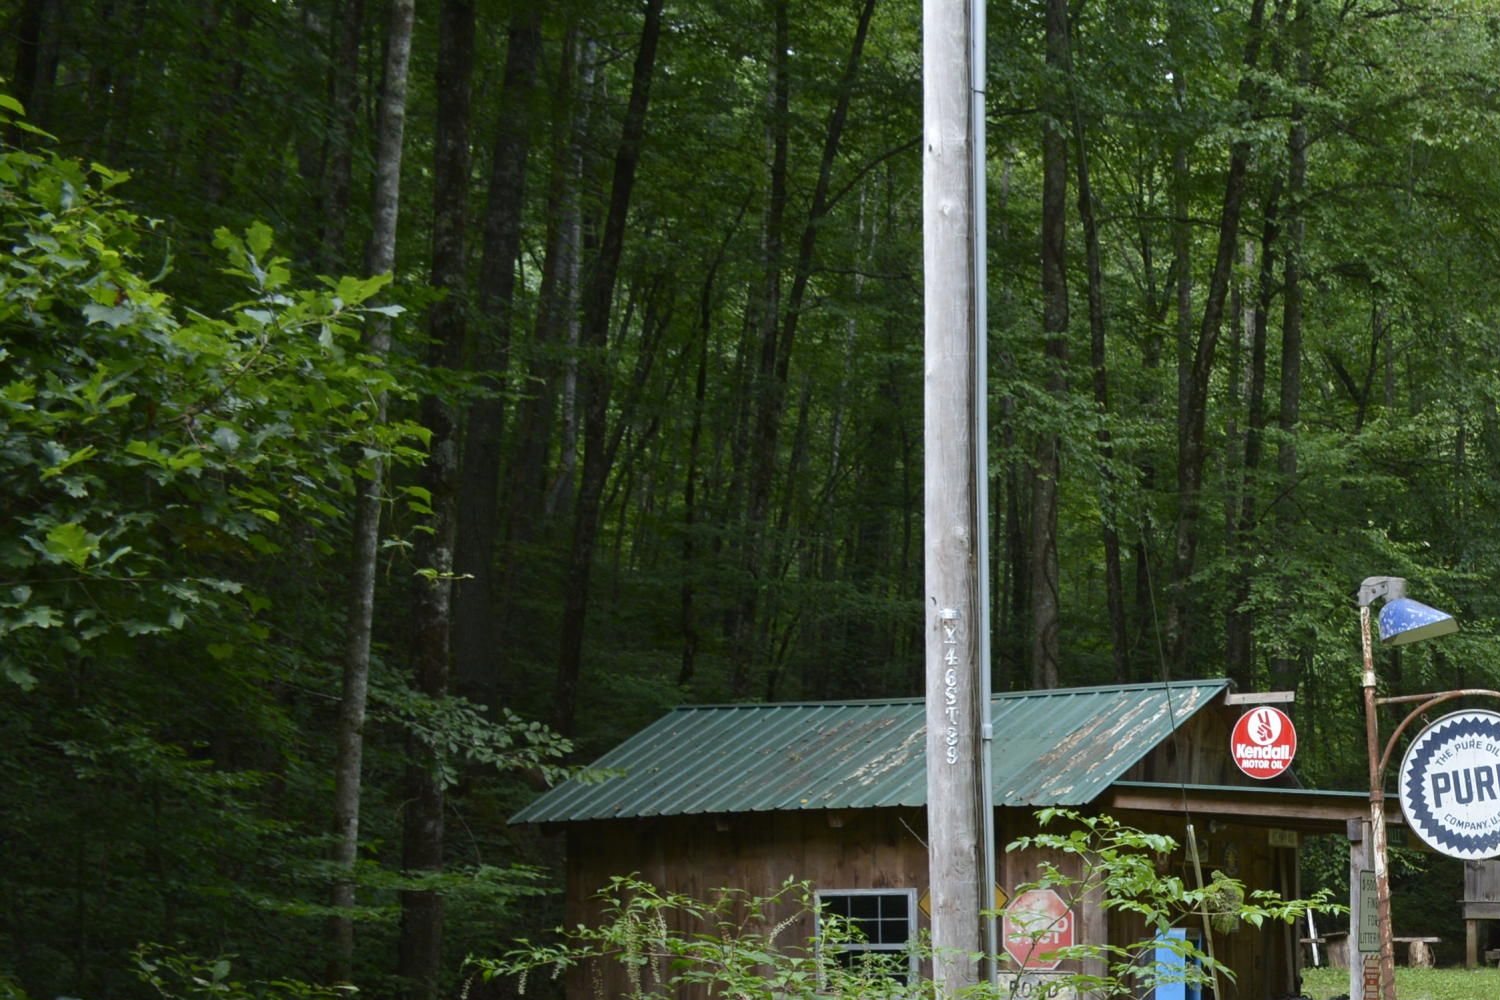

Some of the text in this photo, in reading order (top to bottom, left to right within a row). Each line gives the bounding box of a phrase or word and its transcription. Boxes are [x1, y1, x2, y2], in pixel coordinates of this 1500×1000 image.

[1236, 743, 1290, 759] Kendall
[1435, 739, 1500, 766] THE PURE OIL
[1242, 759, 1283, 769] MOTOR OIL
